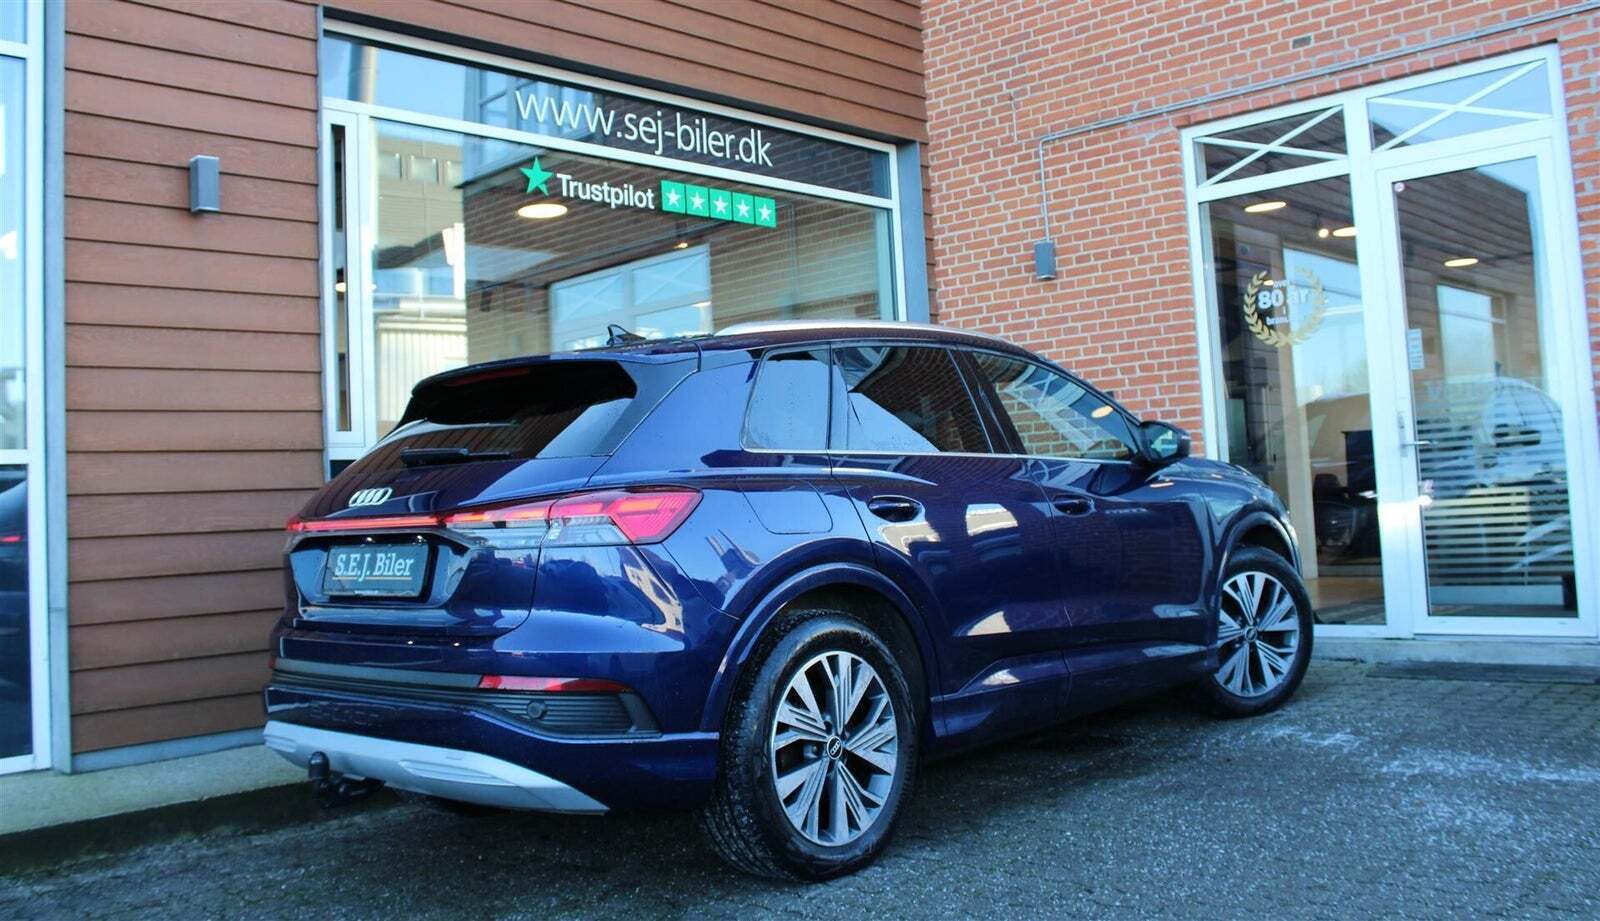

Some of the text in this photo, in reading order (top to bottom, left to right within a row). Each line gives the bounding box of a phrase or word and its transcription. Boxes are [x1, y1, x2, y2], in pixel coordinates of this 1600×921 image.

[515, 90, 773, 167] www.sej-biler.dk
[556, 173, 655, 209] Trustpilot
[1258, 289, 1284, 309] 80
[334, 553, 415, 581] S.E.J. Biler
